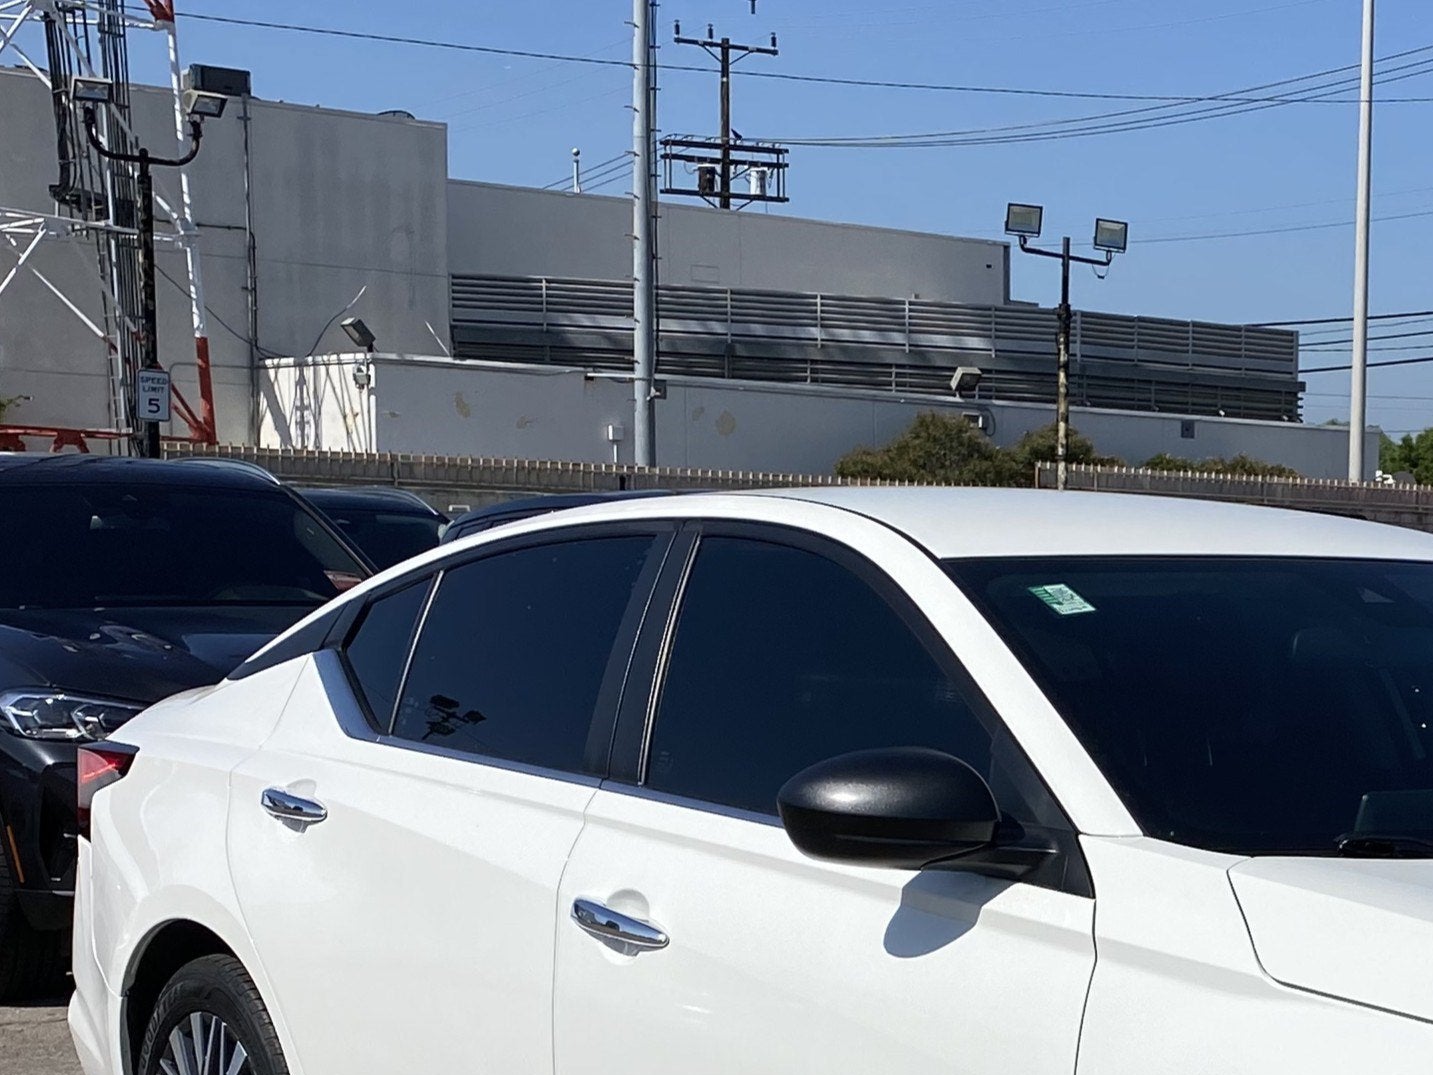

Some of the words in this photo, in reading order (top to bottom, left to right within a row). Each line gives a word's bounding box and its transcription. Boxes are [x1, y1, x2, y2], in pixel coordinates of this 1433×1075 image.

[140, 376, 168, 385] SPEED
[143, 385, 165, 394] LIMIT
[147, 398, 161, 414] 5
